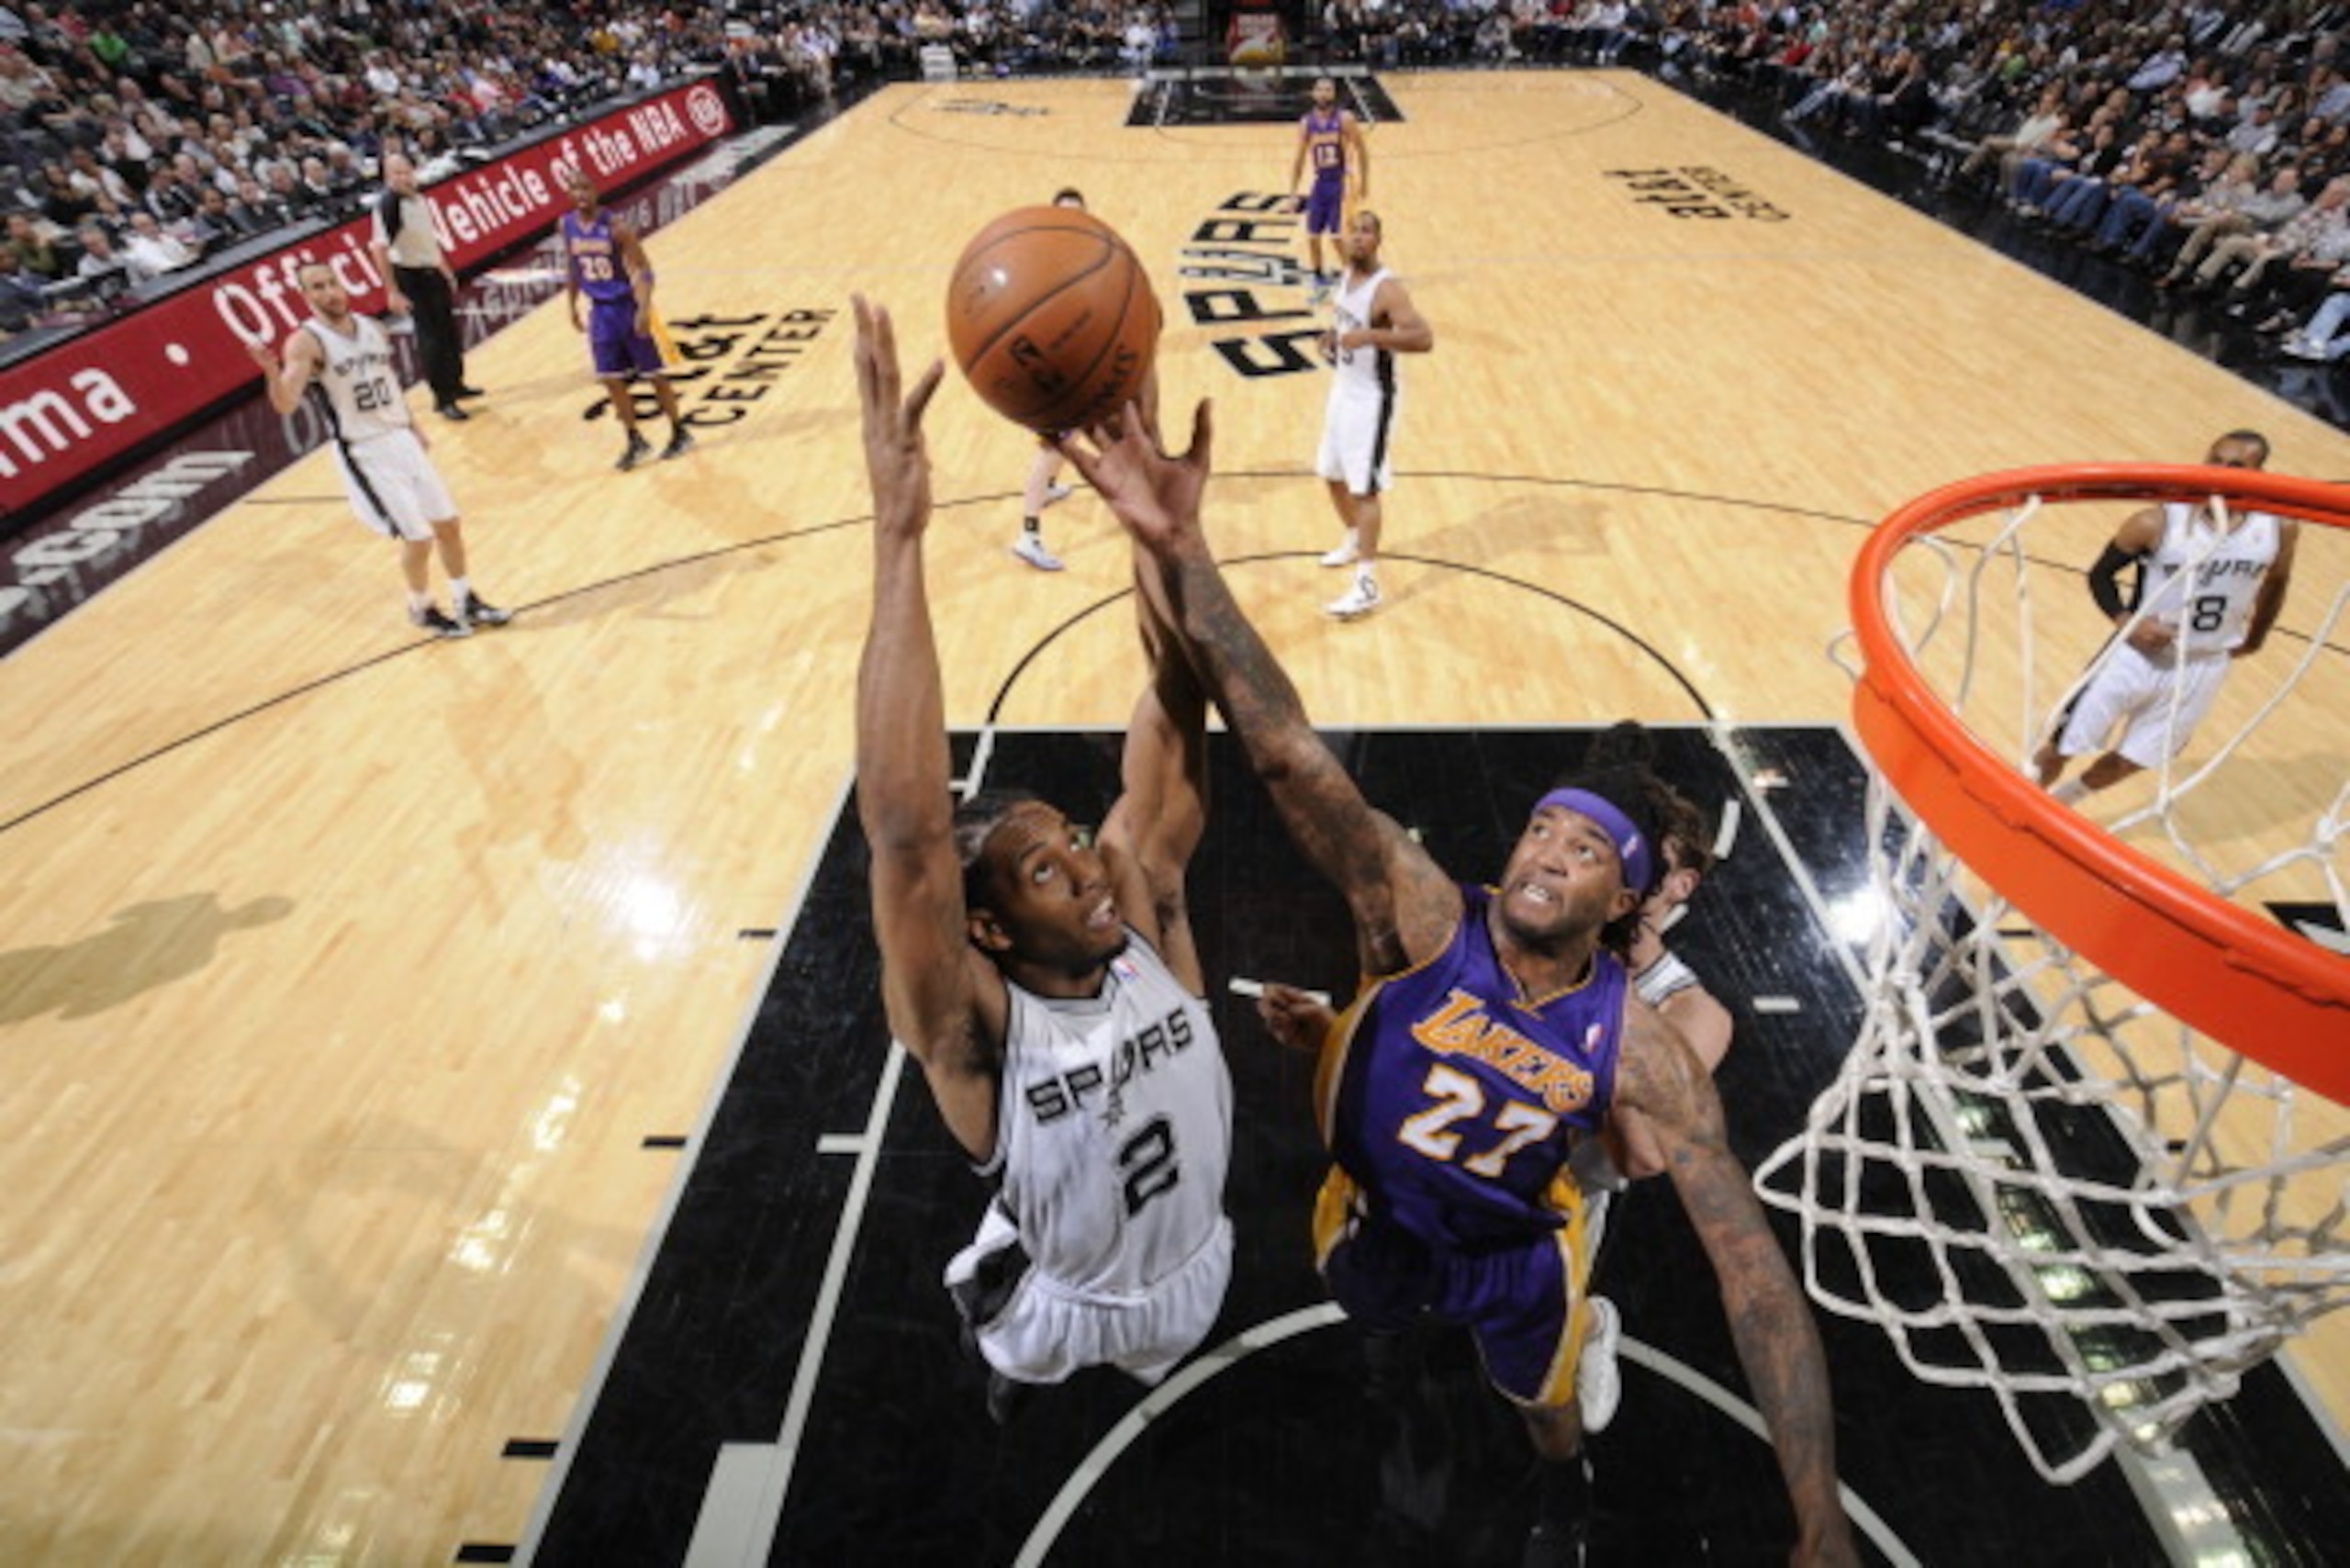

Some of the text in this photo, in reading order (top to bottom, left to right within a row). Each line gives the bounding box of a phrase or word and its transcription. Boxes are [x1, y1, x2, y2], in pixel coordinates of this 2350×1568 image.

[0, 368, 136, 477] ma
[213, 232, 383, 348] Offci
[427, 163, 551, 252] Vehicle
[551, 139, 583, 191] of
[583, 127, 637, 175] the
[628, 101, 686, 155] NBA
[1179, 191, 1327, 378] SPURS
[353, 377, 392, 410] 20
[677, 308, 837, 425] CENTER
[2192, 595, 2227, 632] 8
[1025, 1008, 1193, 1124] SPURS
[1411, 990, 1593, 1113] LAKERS
[1119, 1116, 1180, 1215] 2
[1399, 1065, 1559, 1178] 27
